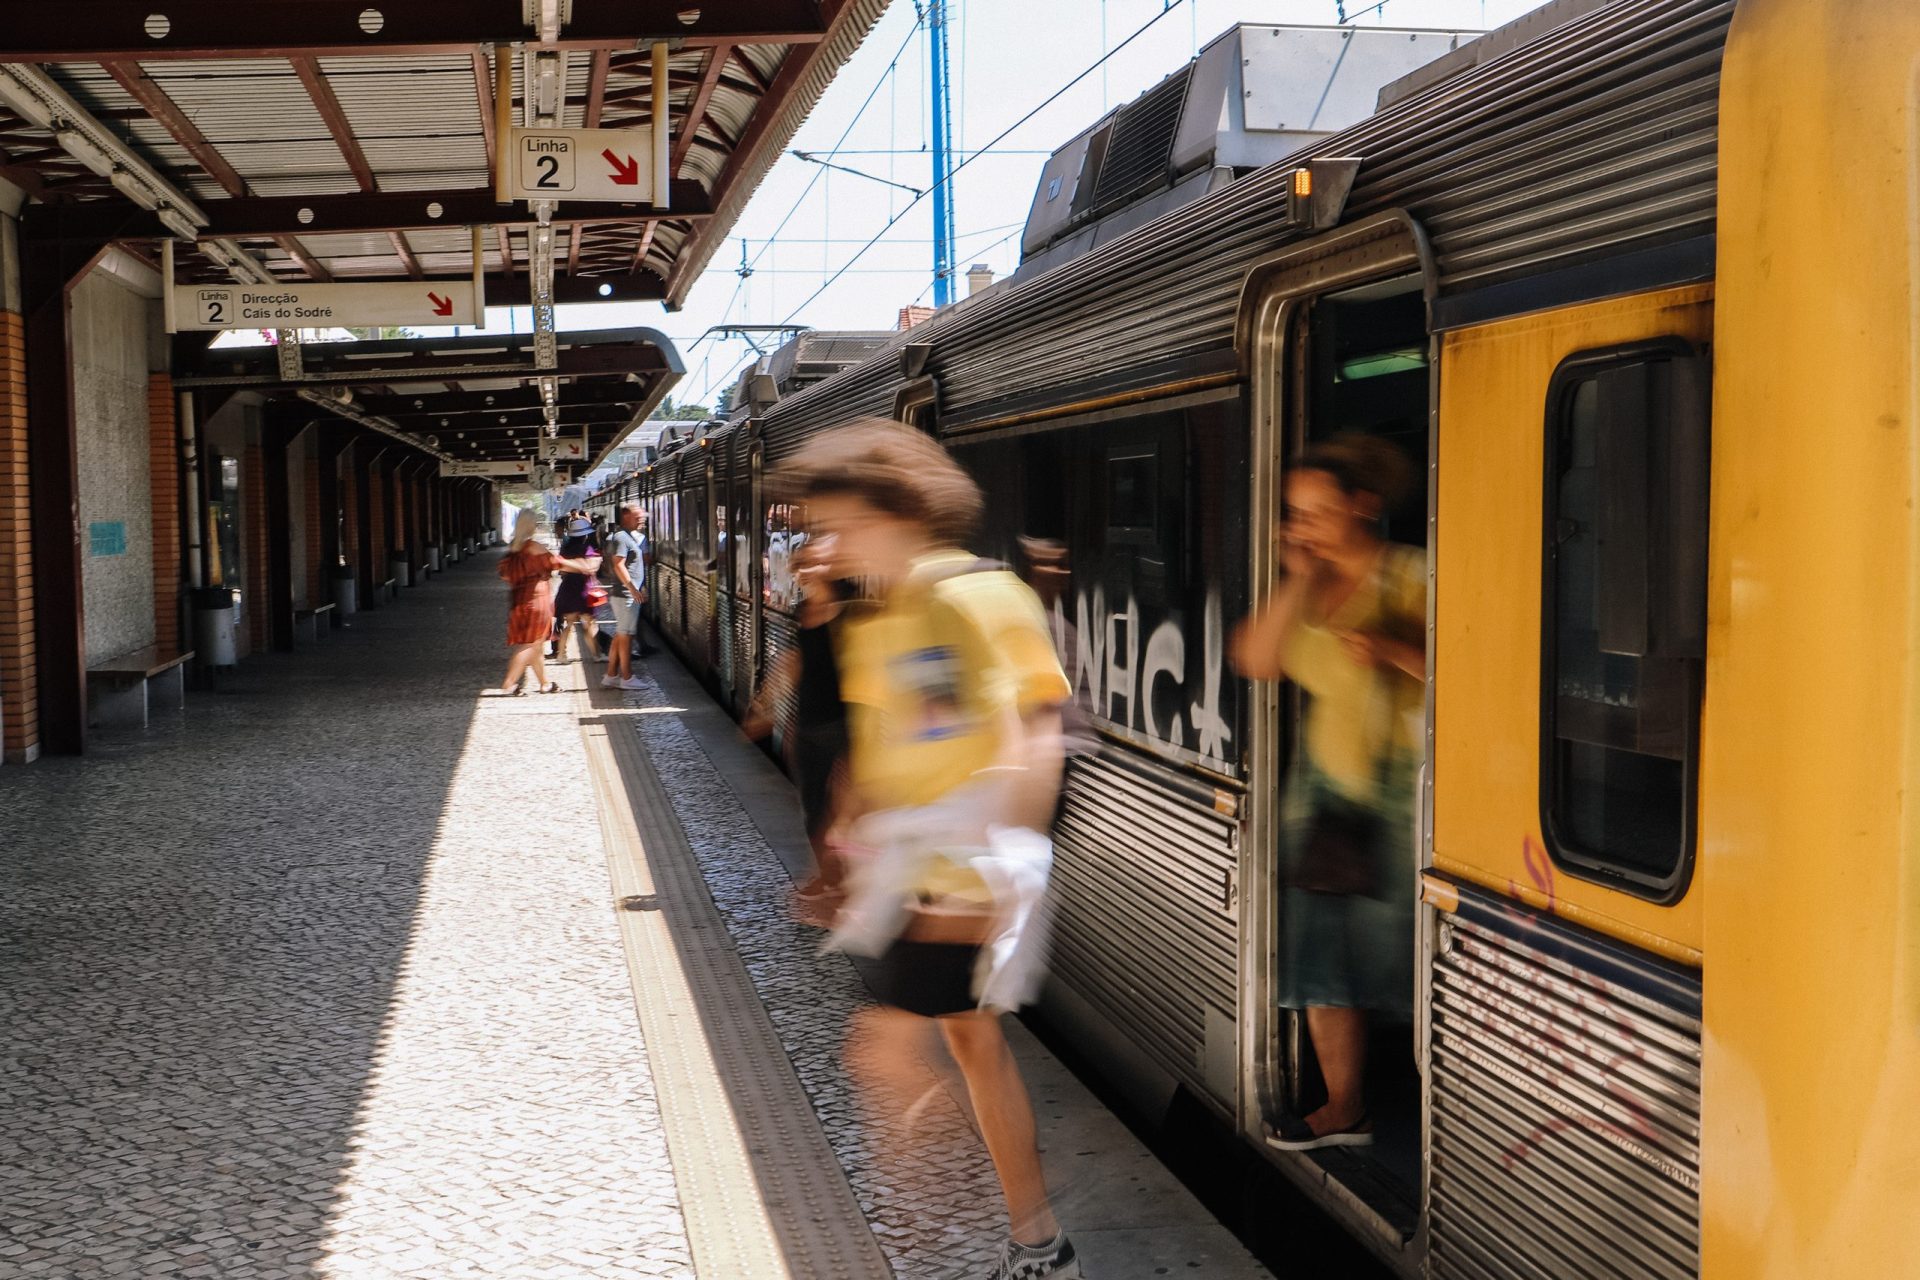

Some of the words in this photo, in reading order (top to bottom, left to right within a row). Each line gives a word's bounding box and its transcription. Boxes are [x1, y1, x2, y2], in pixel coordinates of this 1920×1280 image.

[527, 139, 568, 152] Linha
[536, 155, 560, 188] 2
[201, 292, 228, 301] Linha
[242, 293, 299, 305] Direcção
[207, 302, 224, 323] 2
[242, 308, 271, 319] Cais
[274, 308, 291, 318] do
[294, 306, 333, 318] Sodré
[550, 447, 557, 456] 2
